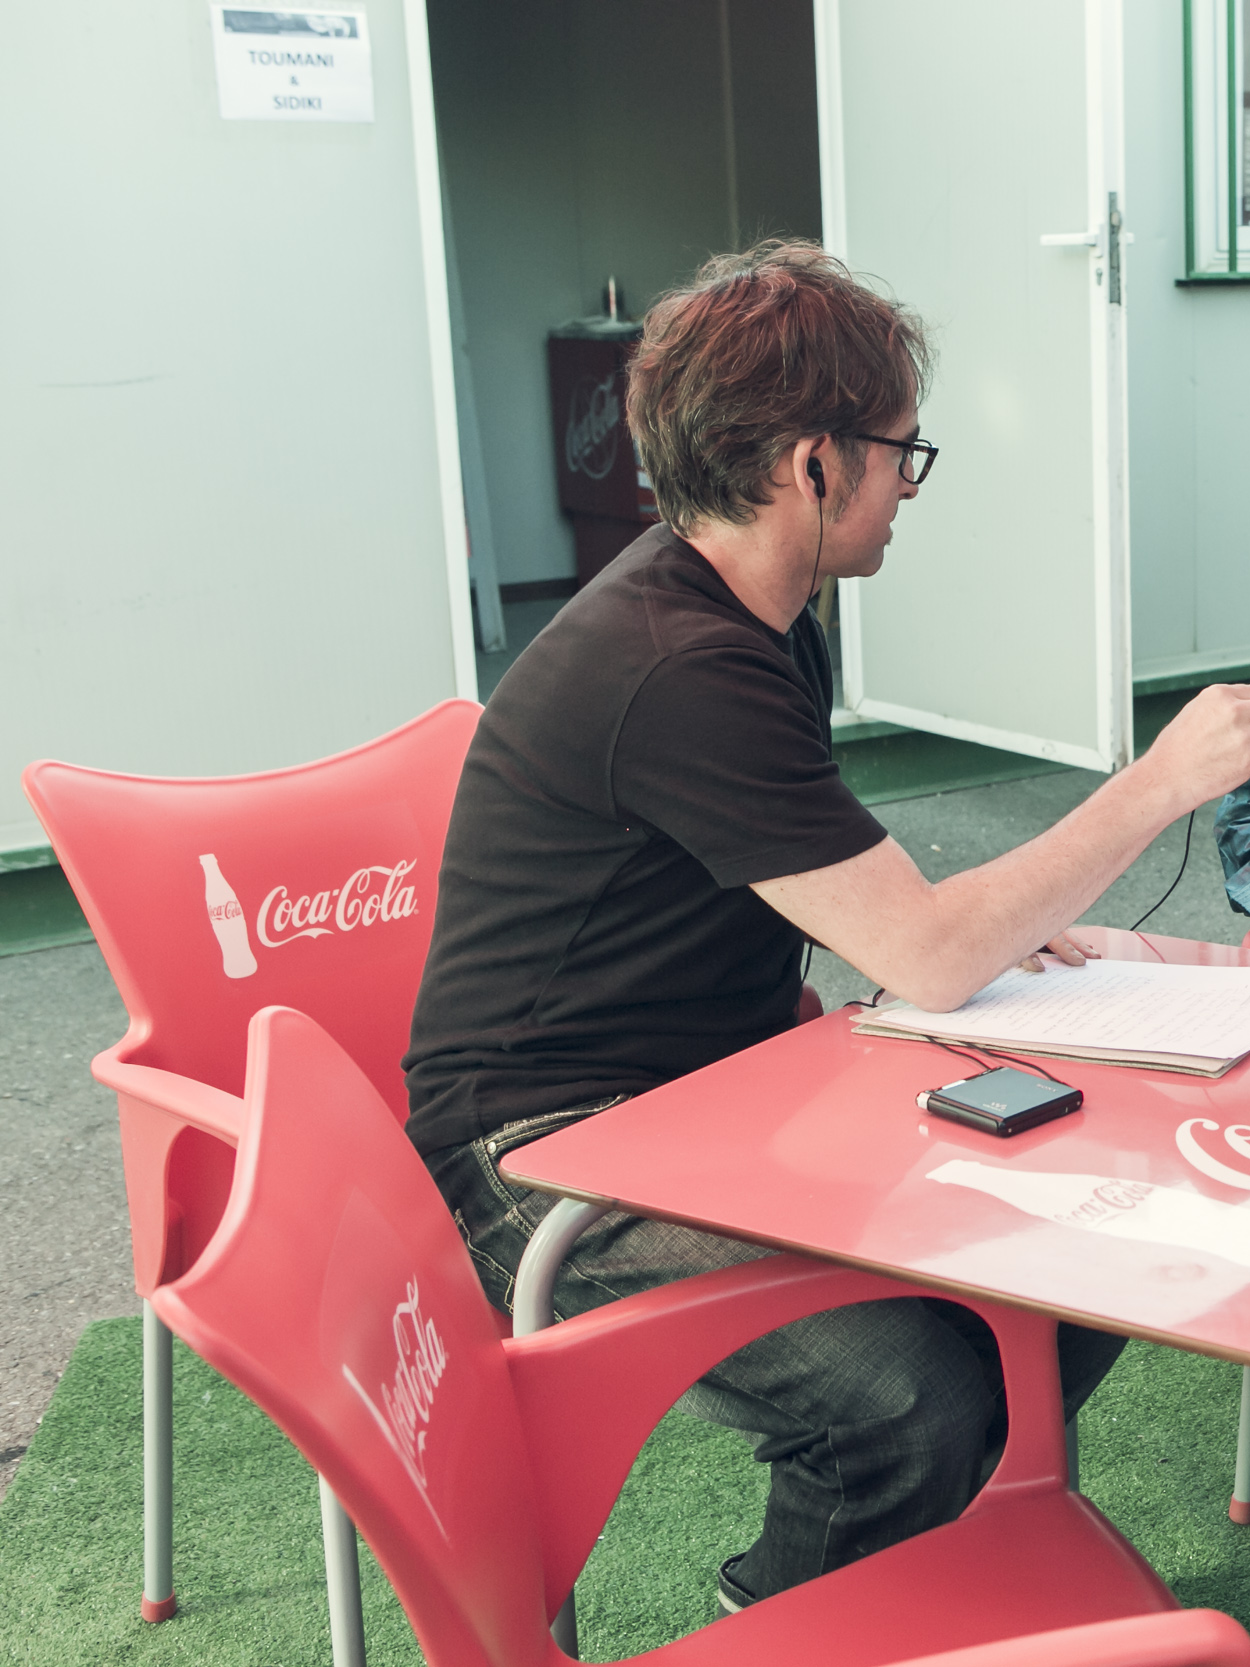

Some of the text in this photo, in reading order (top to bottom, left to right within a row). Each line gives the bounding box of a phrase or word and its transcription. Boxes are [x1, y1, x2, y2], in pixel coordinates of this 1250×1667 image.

[248, 50, 334, 67] TOUMANI
[289, 75, 299, 86] &
[273, 95, 322, 110] SIDIKI
[256, 857, 418, 948] Coca-Cola
